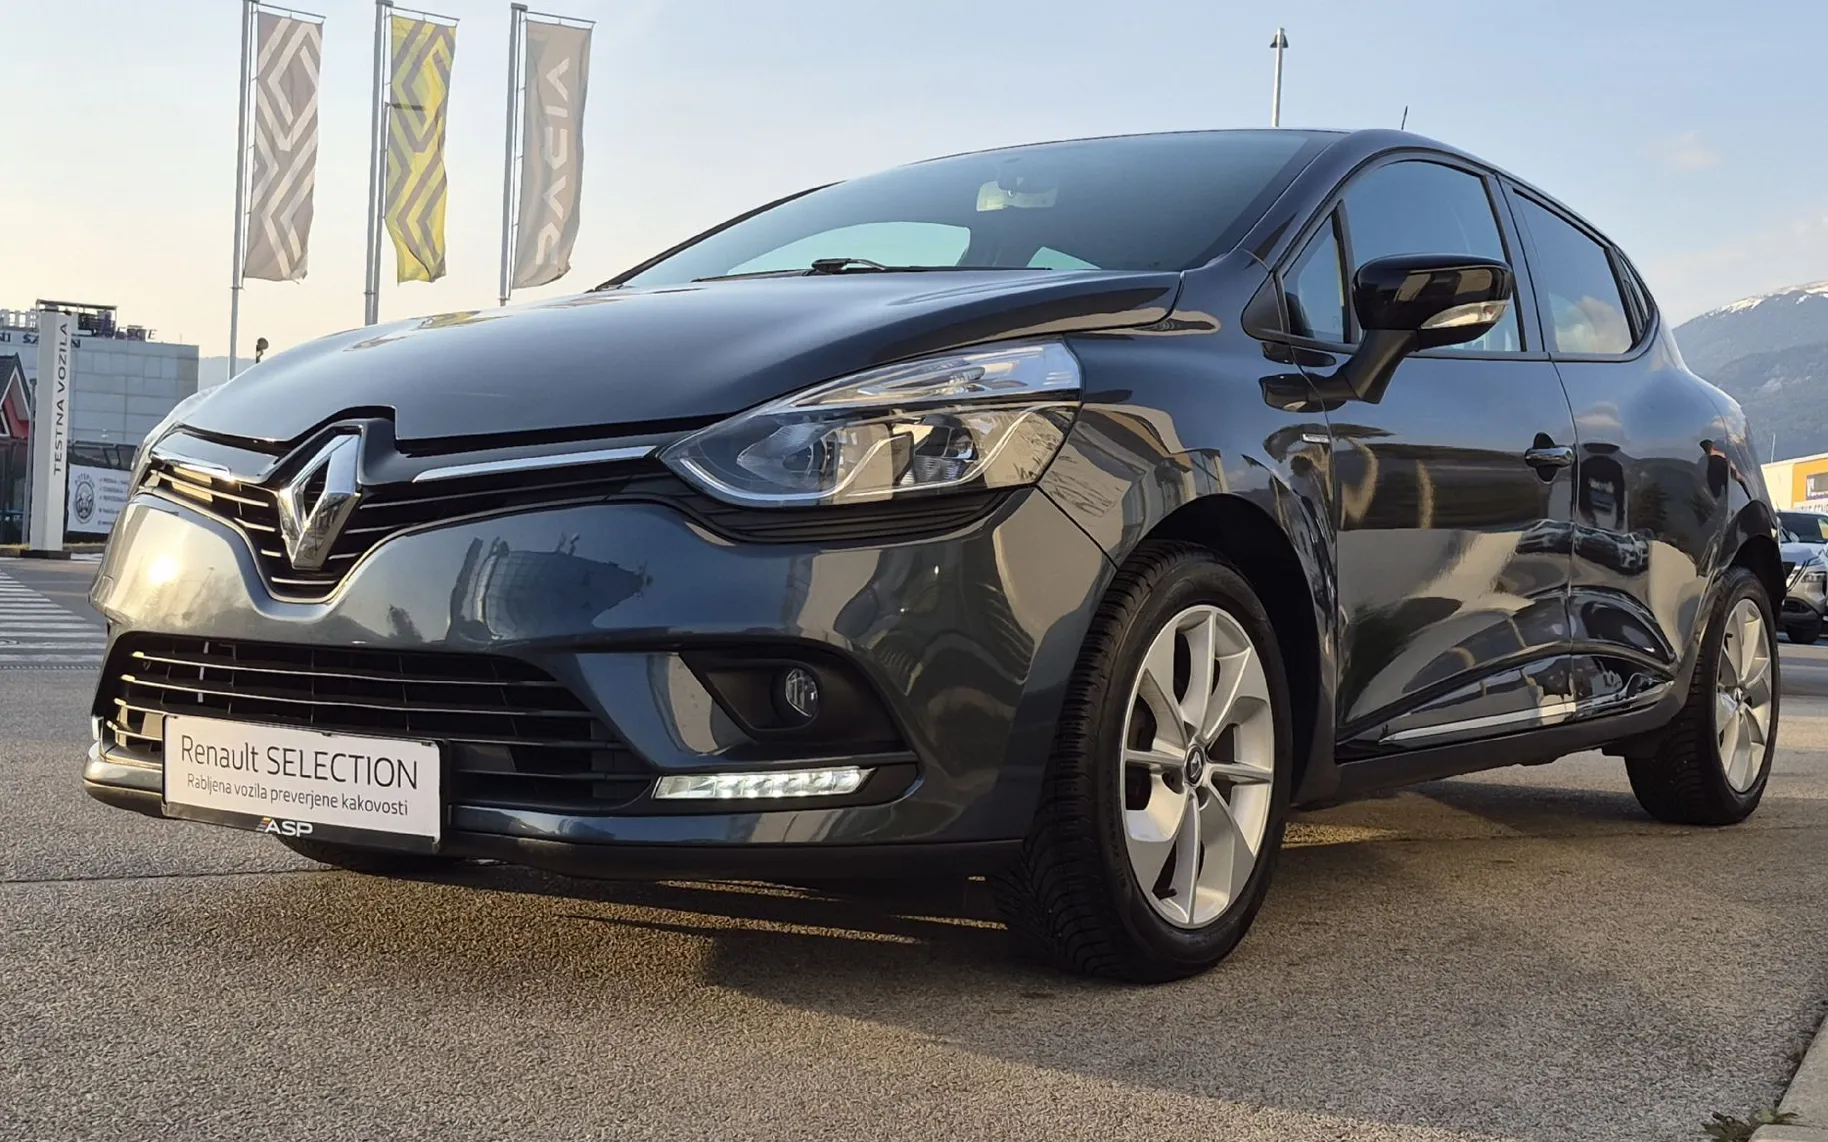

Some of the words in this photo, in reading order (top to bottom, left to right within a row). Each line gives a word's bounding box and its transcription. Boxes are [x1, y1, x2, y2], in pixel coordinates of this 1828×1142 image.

[536, 57, 570, 265] DACIA
[57, 323, 69, 393] VOZILA
[54, 399, 65, 476] TESTNA
[181, 734, 260, 773] Renault
[266, 745, 419, 791] SELECTION
[187, 773, 233, 795] Rabljena
[234, 781, 268, 800] vozila
[270, 787, 338, 810] preverjene
[341, 793, 409, 816] kakovosti
[264, 818, 313, 838] ASP
